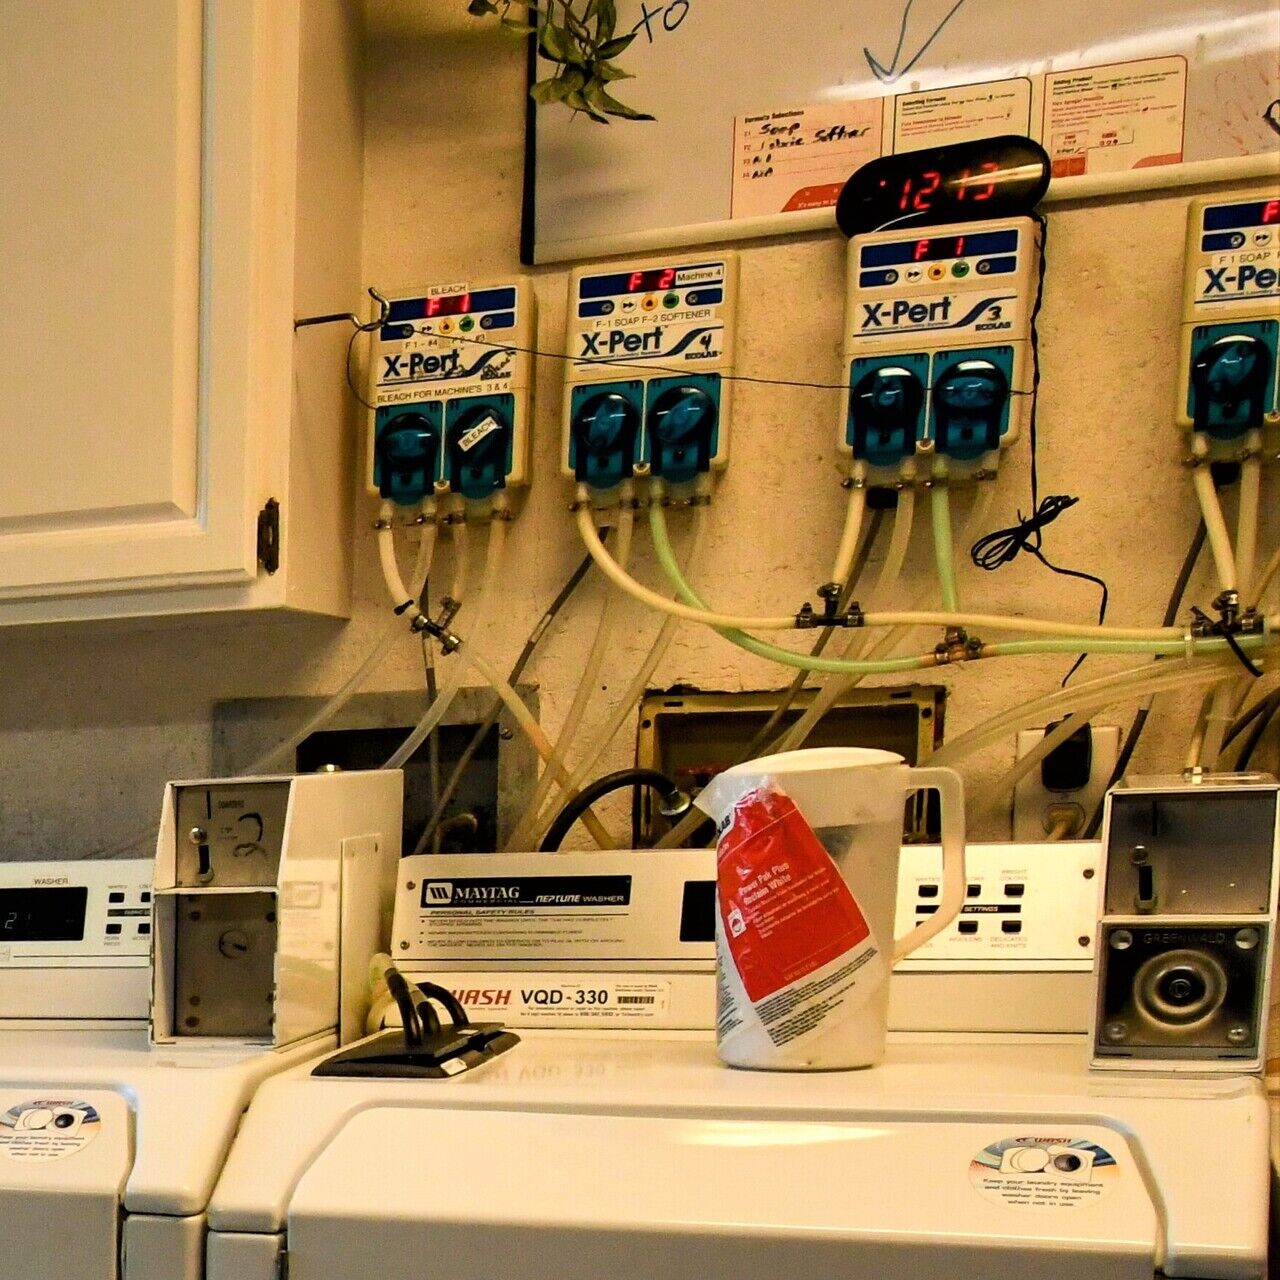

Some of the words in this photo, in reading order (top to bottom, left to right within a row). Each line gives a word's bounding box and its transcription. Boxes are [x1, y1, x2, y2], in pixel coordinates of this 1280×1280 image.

[677, 272, 713, 282] Machine
[1203, 265, 1280, 293] X-Pe
[431, 284, 466, 296] BLEACH
[615, 317, 639, 326] SOAP
[661, 309, 711, 322] SOFTENER
[862, 297, 951, 328] X-Pert
[976, 322, 1011, 331] ECOLAB
[581, 326, 663, 356] X-Pert
[383, 348, 460, 378] X-Pert
[685, 352, 718, 360] ECOLAB
[378, 392, 412, 402] BLEACH
[414, 389, 432, 400] FOR
[461, 417, 497, 450] BLEACH
[455, 886, 520, 900] MAYTAG
[535, 895, 581, 903] NEPTUNE
